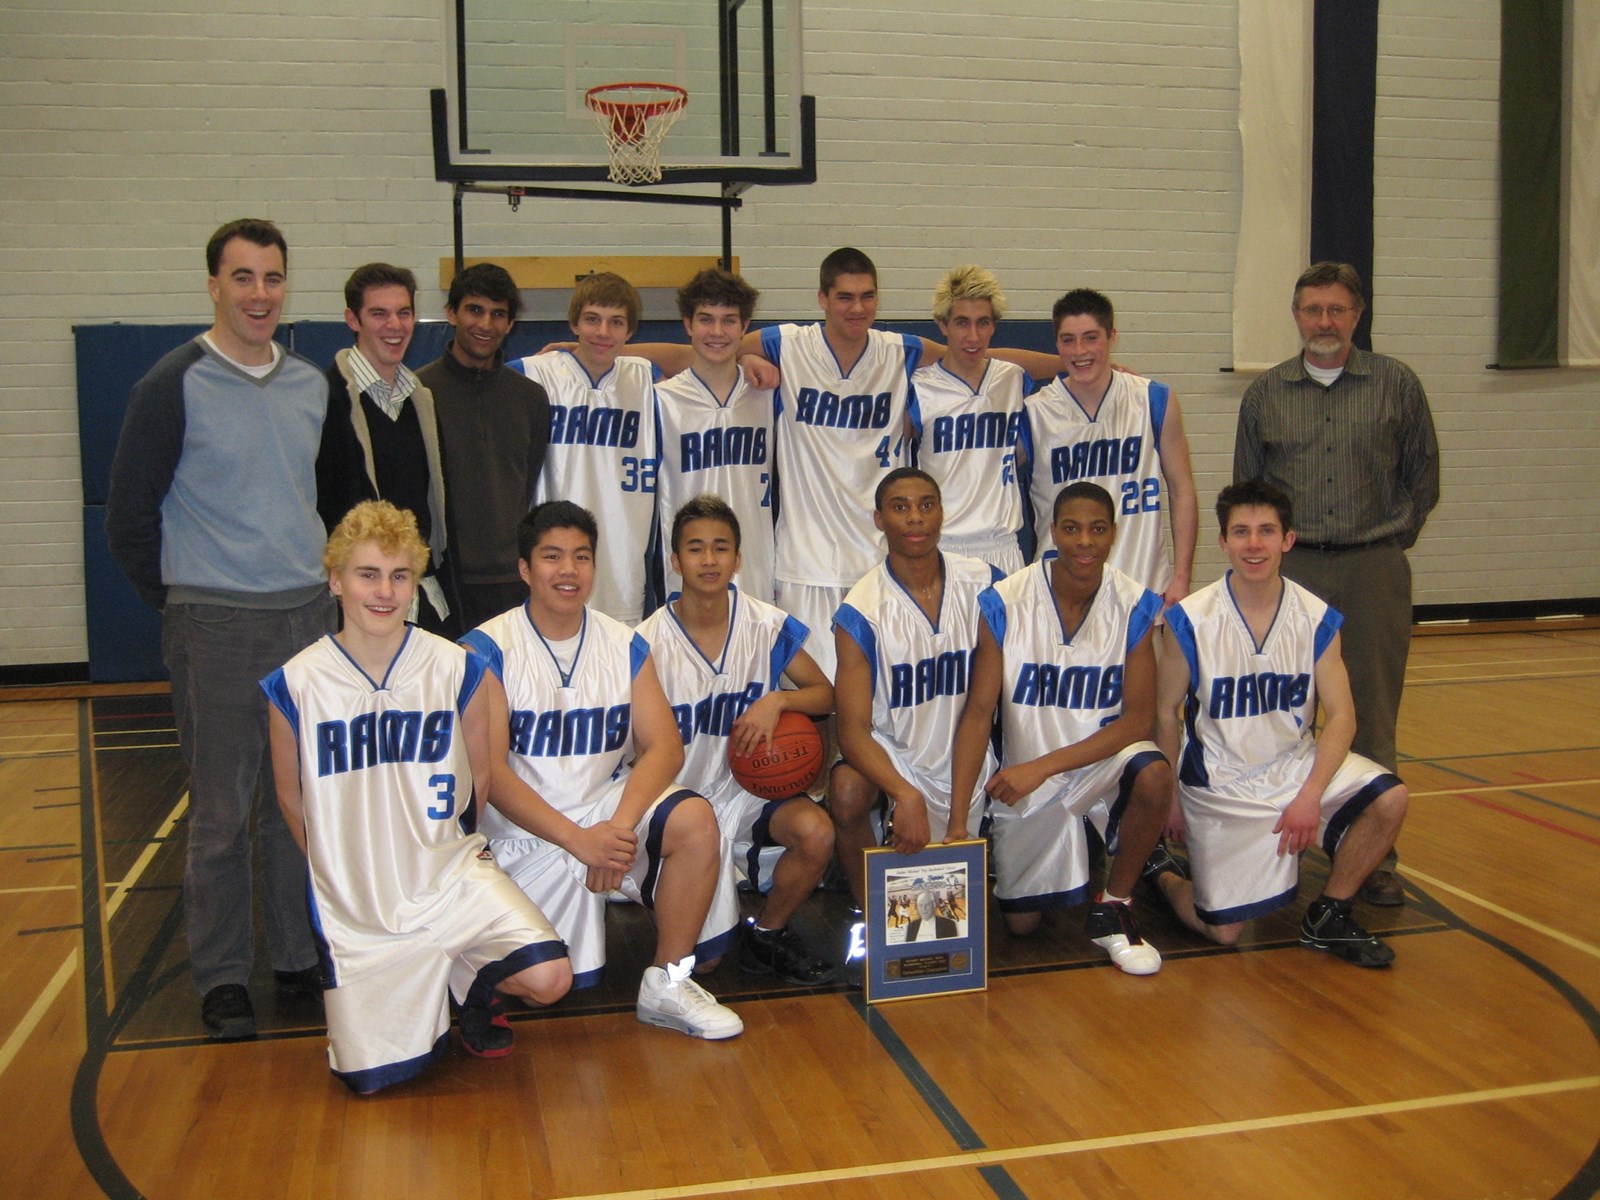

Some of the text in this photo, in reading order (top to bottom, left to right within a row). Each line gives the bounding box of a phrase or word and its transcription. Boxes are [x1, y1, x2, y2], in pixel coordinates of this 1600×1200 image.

[550, 404, 641, 449] RAMS
[796, 387, 892, 429] RAMS
[681, 426, 767, 474] RAMS
[1051, 435, 1142, 485] RAMS
[620, 456, 656, 493] 32
[760, 473, 771, 507] 7
[1121, 477, 1160, 516] 22
[890, 646, 978, 709] RAM
[1011, 662, 1124, 710] RAMS
[1208, 671, 1311, 720] RAMS
[316, 709, 455, 778] RAMS
[509, 703, 631, 757] RAMS
[427, 773, 456, 820] 3
